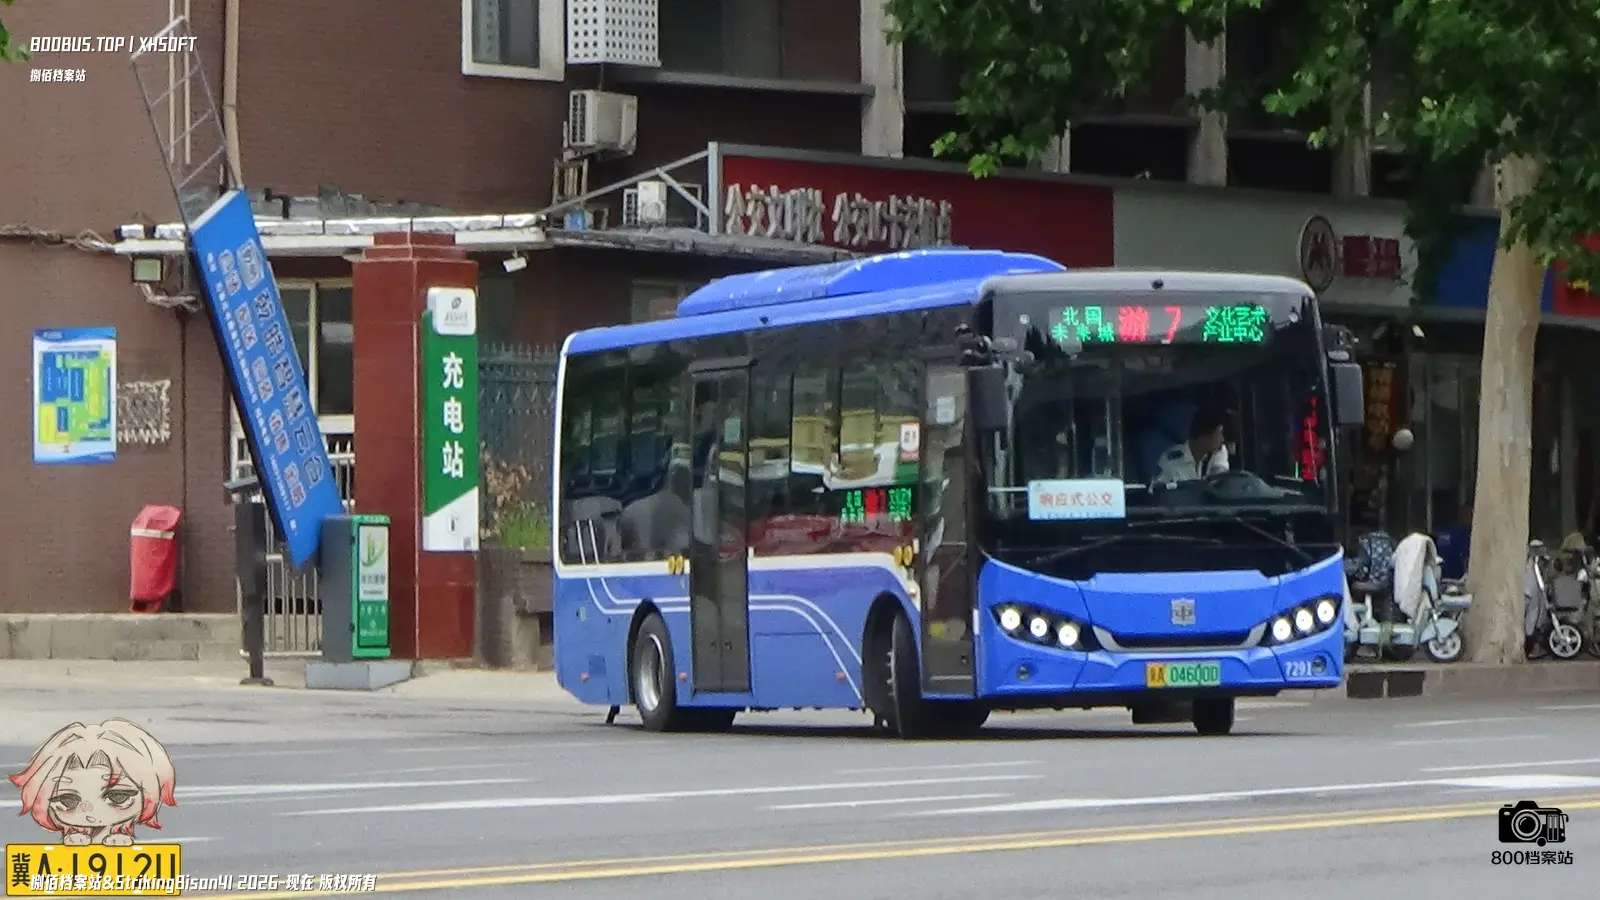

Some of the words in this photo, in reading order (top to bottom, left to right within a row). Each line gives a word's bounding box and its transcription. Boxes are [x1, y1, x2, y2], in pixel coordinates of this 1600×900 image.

[1160, 305, 1182, 345] 7
[1205, 305, 1267, 326] 文化艺术
[1203, 321, 1265, 343] 产业中心
[442, 351, 465, 479] 充电站
[1040, 491, 1113, 507] 响应式公交
[1285, 660, 1313, 677] 7291
